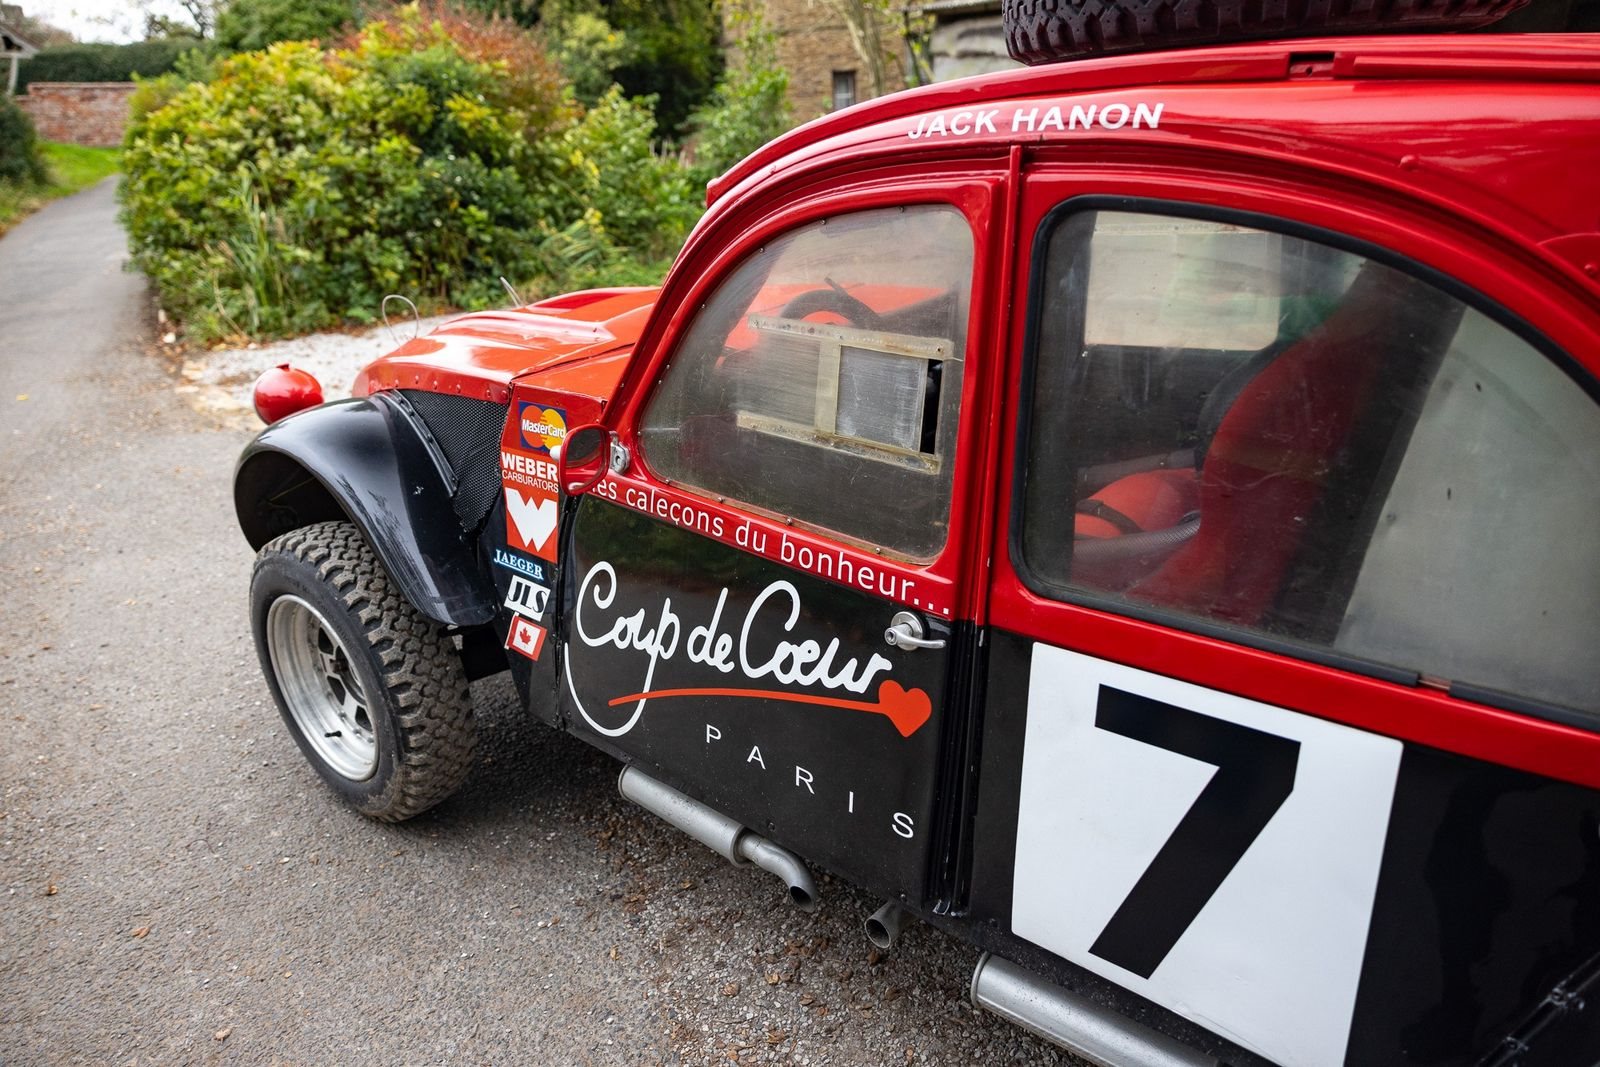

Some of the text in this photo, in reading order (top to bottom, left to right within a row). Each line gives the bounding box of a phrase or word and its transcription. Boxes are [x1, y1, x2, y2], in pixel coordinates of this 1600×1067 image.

[907, 102, 1165, 139] JACK HANON
[521, 418, 566, 438] MasterCard
[501, 451, 558, 482] WEBER
[502, 469, 559, 493] CARBURATORS
[592, 479, 617, 500] es
[626, 487, 724, 537] caleçons
[735, 521, 766, 553] du
[493, 549, 544, 580] JAEGER
[508, 581, 547, 613] JLS
[565, 561, 681, 737] Coup
[687, 587, 735, 673] de
[706, 724, 914, 839] PARIS
[1088, 683, 1302, 980] 7
